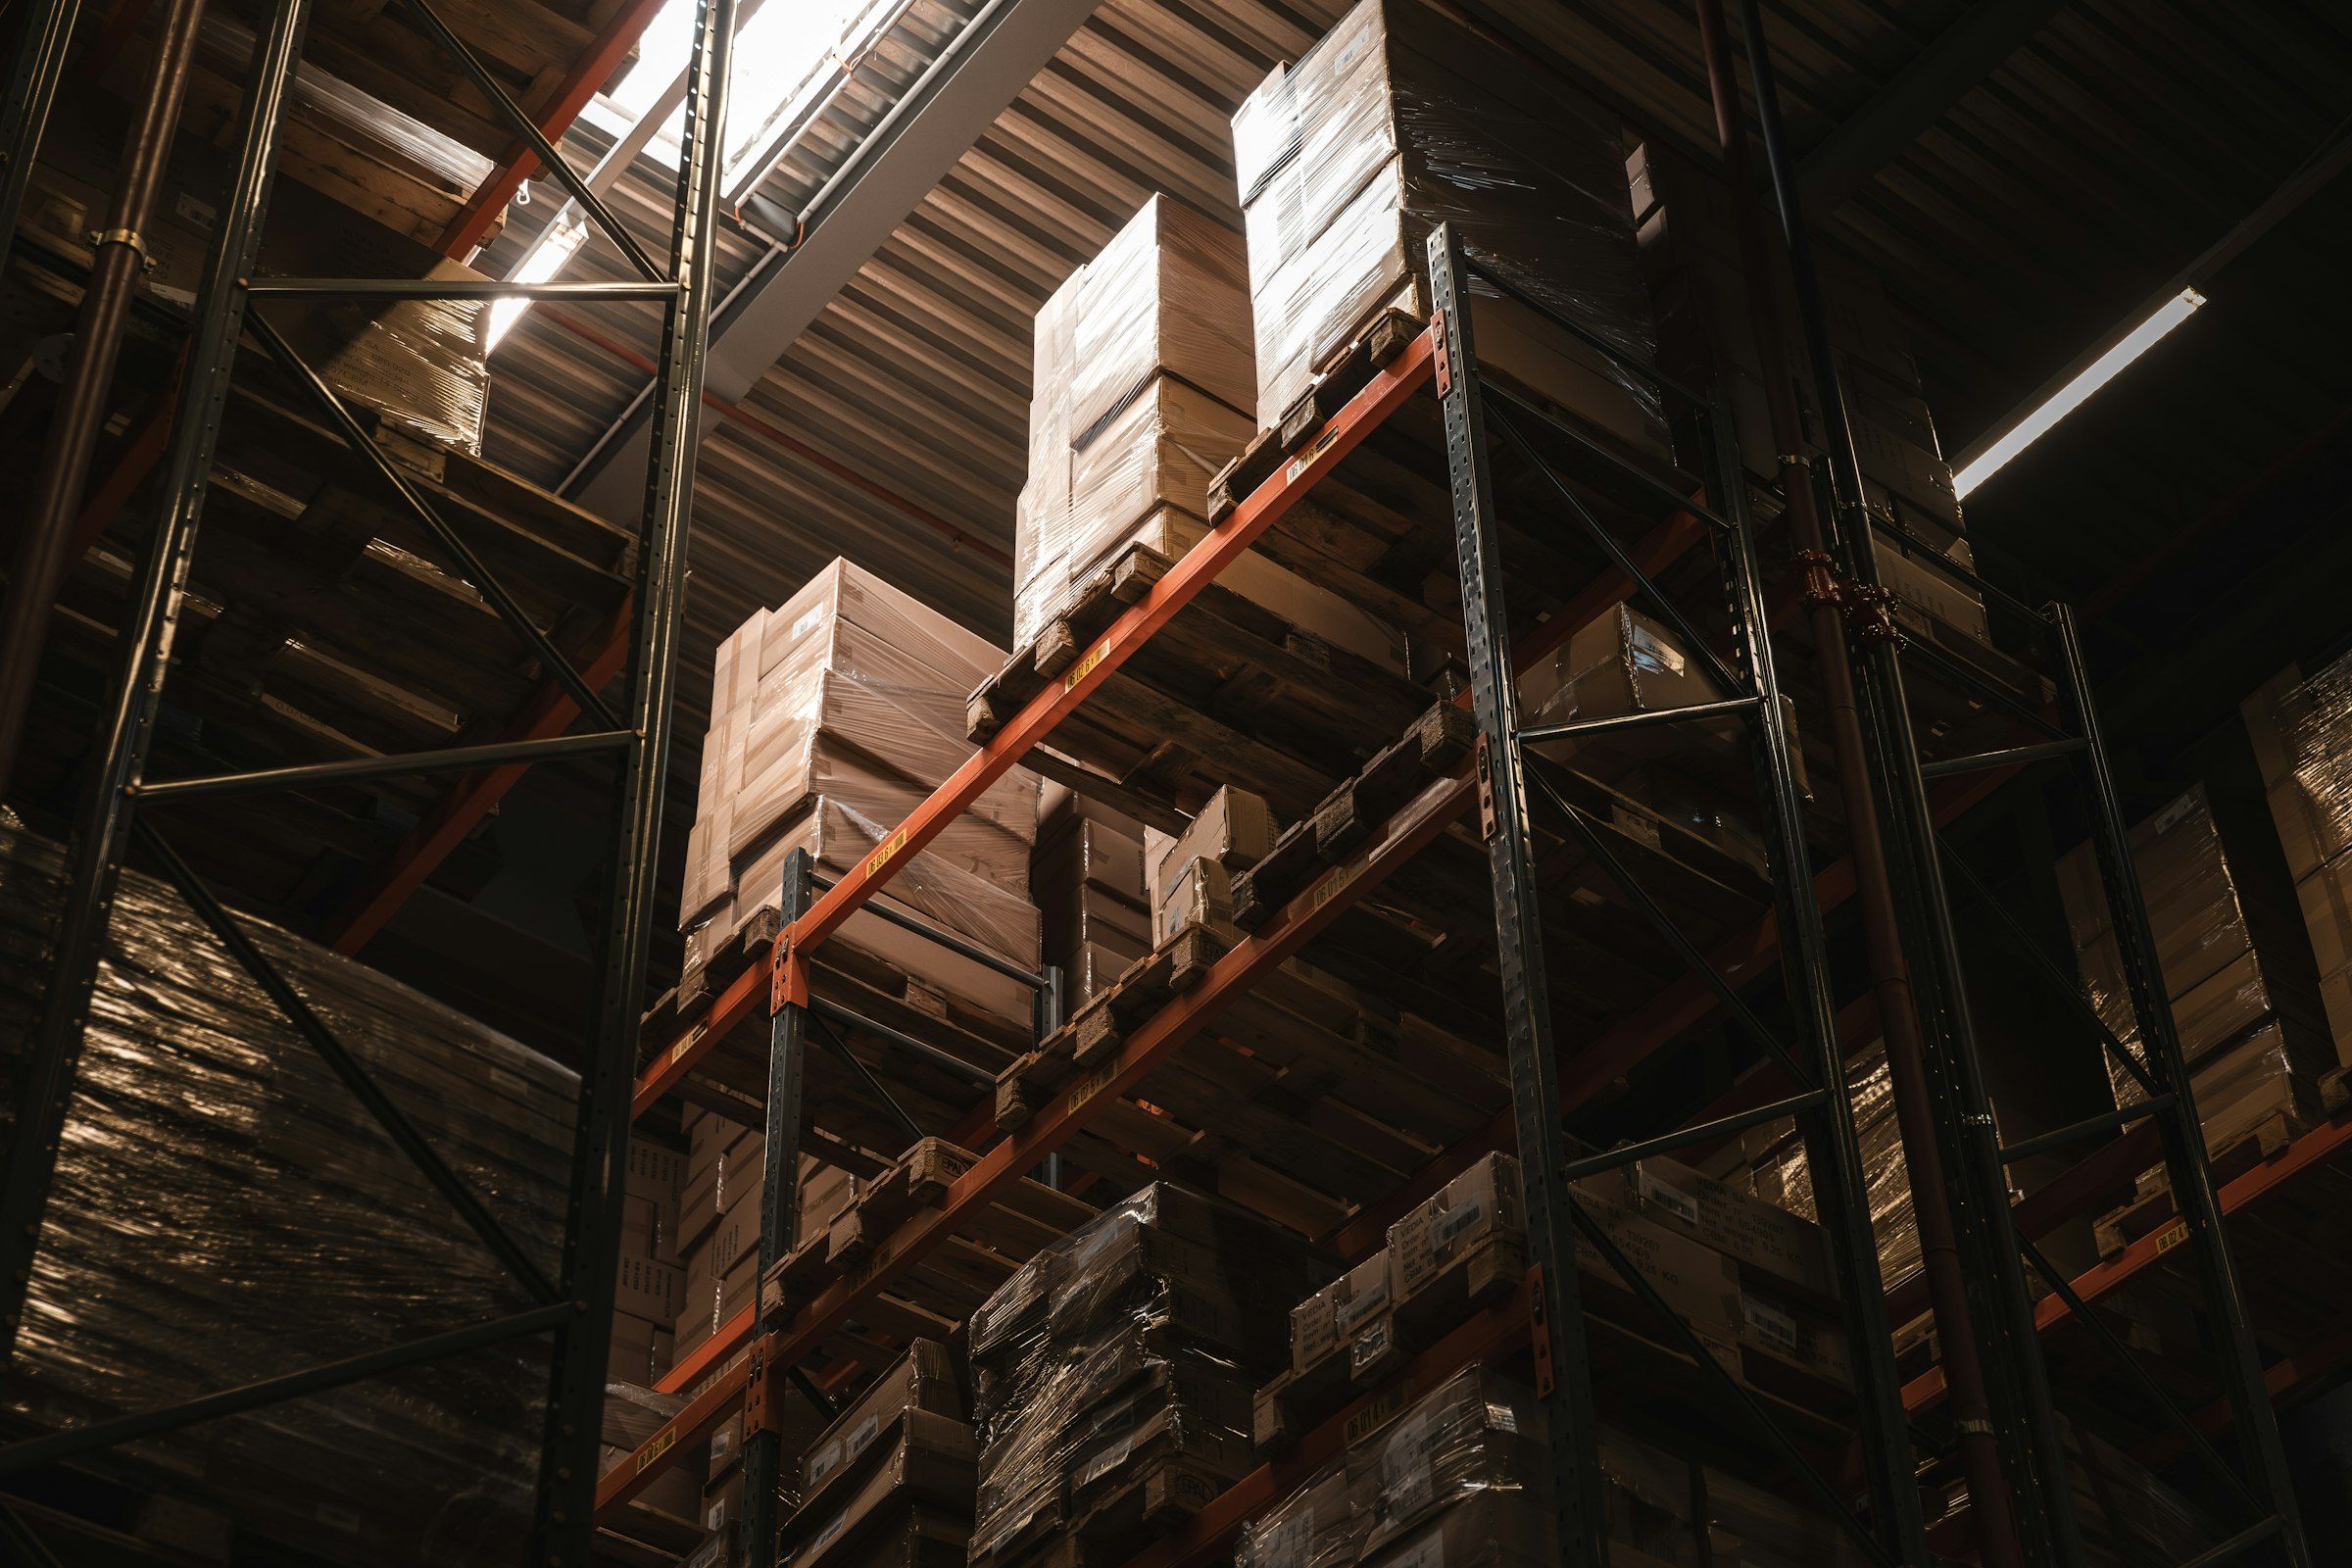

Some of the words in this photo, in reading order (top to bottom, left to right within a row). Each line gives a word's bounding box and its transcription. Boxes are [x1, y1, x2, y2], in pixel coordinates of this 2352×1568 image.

[1068, 672, 1075, 689] 06
[1076, 663, 1084, 681] 02
[1085, 658, 1091, 676] 6
[1661, 1270, 1679, 1286] KG
[1348, 1417, 1359, 1440] 06
